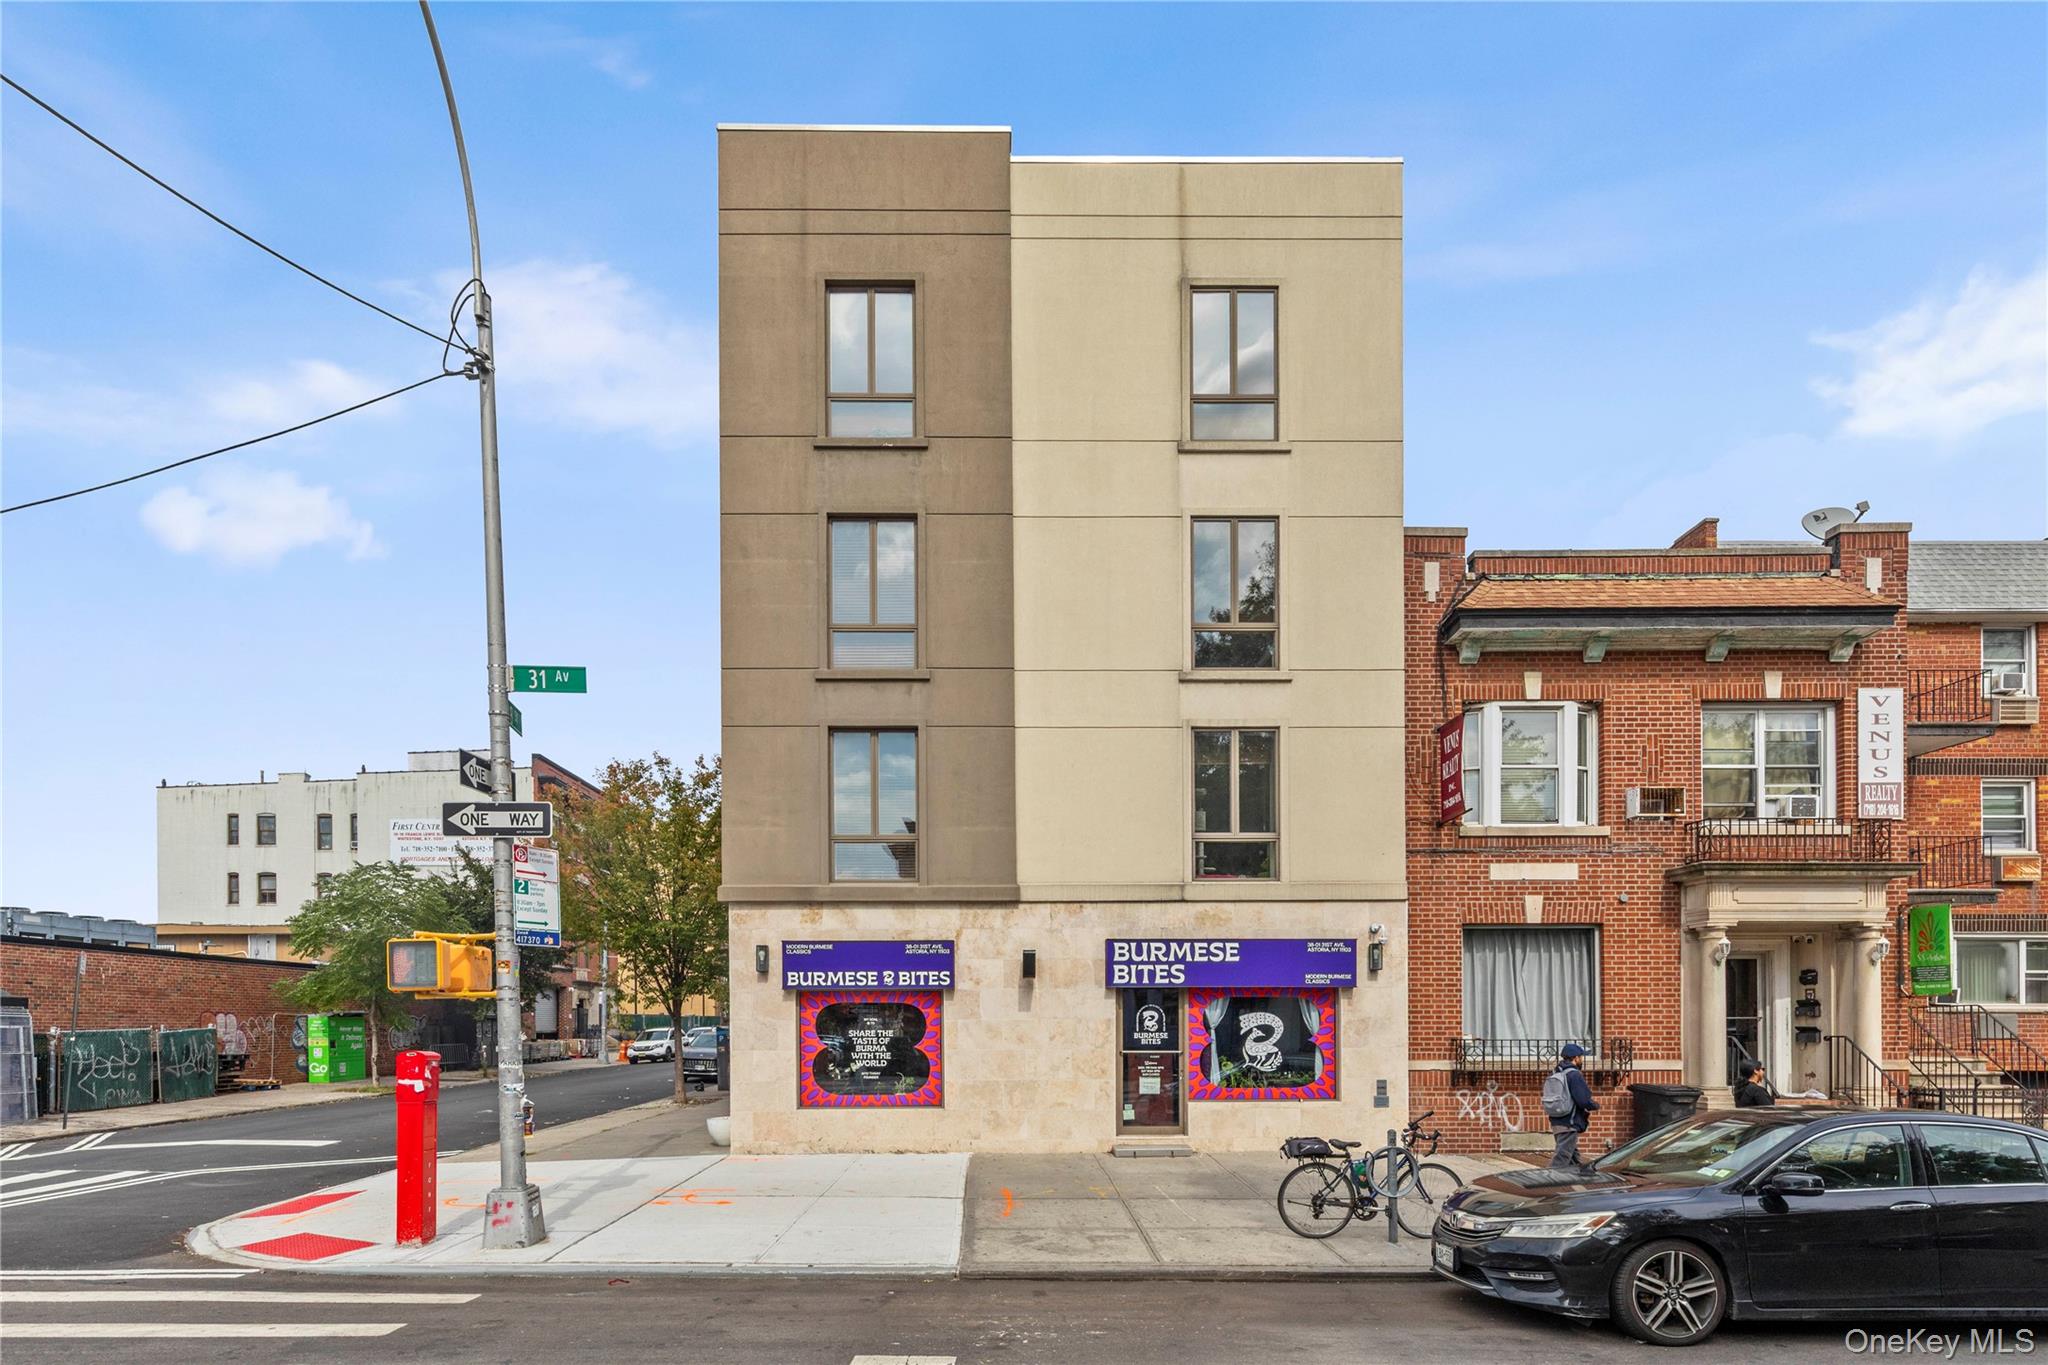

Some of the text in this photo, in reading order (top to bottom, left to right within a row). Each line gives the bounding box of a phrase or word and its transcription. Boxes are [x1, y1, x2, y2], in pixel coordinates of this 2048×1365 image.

[528, 669, 569, 689] 31 Av
[1868, 695, 1892, 778] VENUS
[469, 764, 486, 783] ONE
[1865, 784, 1898, 801] REALTY
[415, 821, 441, 831] CENTR
[460, 813, 539, 826] ONE WAY
[518, 880, 525, 893] 2
[516, 935, 541, 944] 417370
[1113, 942, 1240, 962] BURMESE
[786, 971, 951, 986] BURMESE BITES
[1113, 964, 1185, 984] BITES
[309, 1062, 328, 1073] Go
[855, 1059, 887, 1067] WORLD
